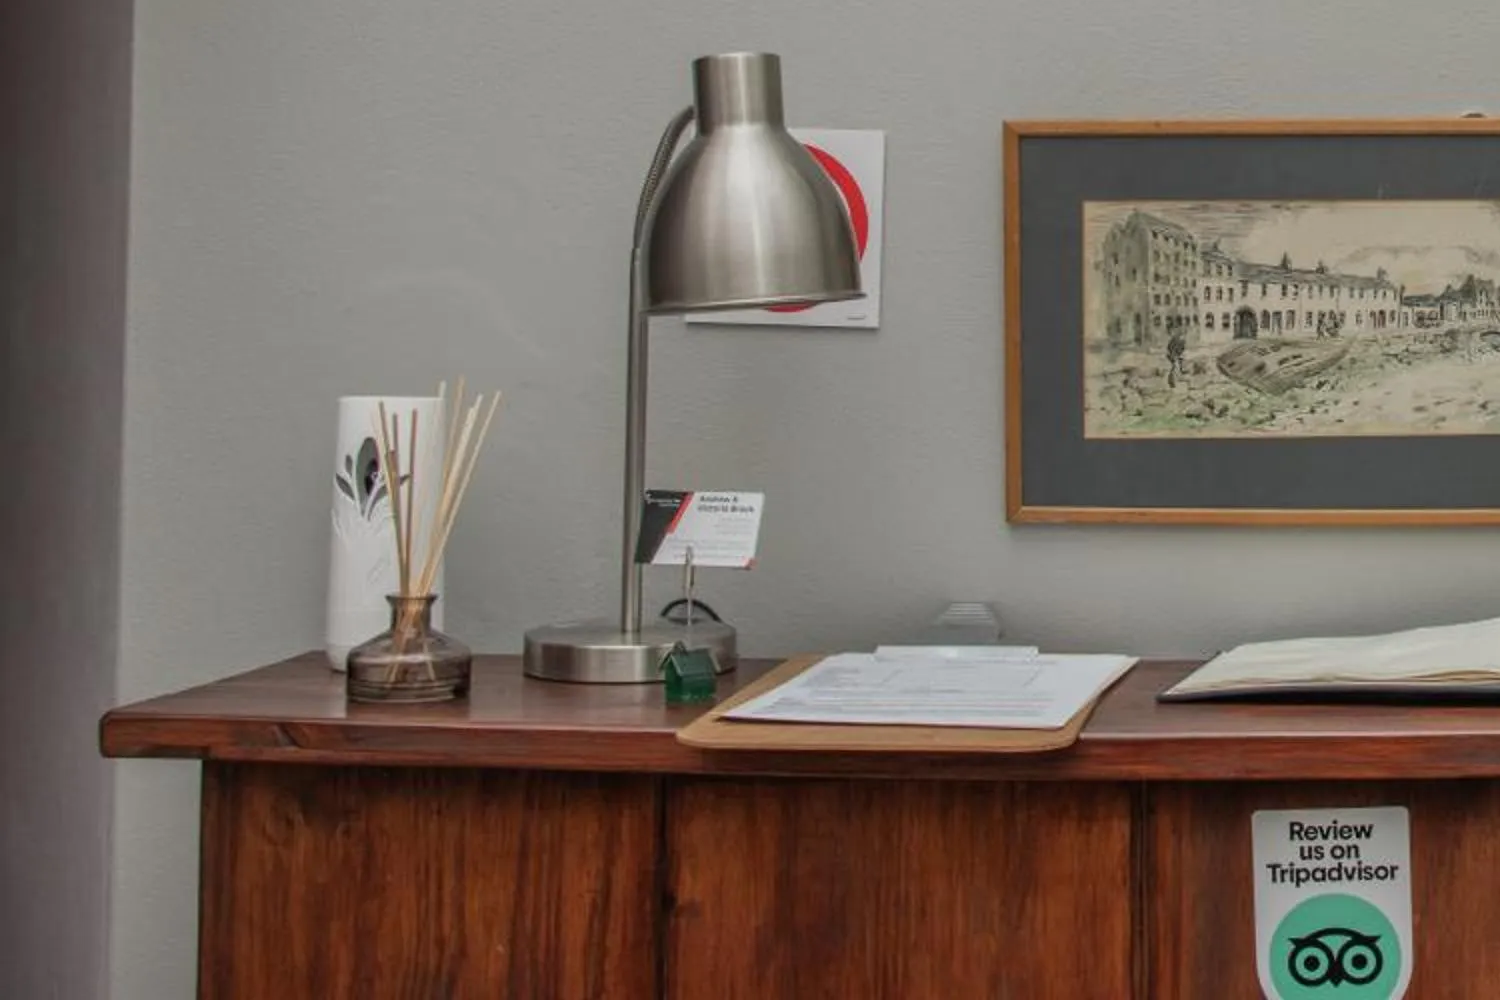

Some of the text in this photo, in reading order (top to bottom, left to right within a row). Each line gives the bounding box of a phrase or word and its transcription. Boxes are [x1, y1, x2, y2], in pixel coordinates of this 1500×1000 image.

[1289, 820, 1374, 841] Review
[1299, 844, 1361, 861] us on
[1266, 861, 1399, 888] Tripadvisor
